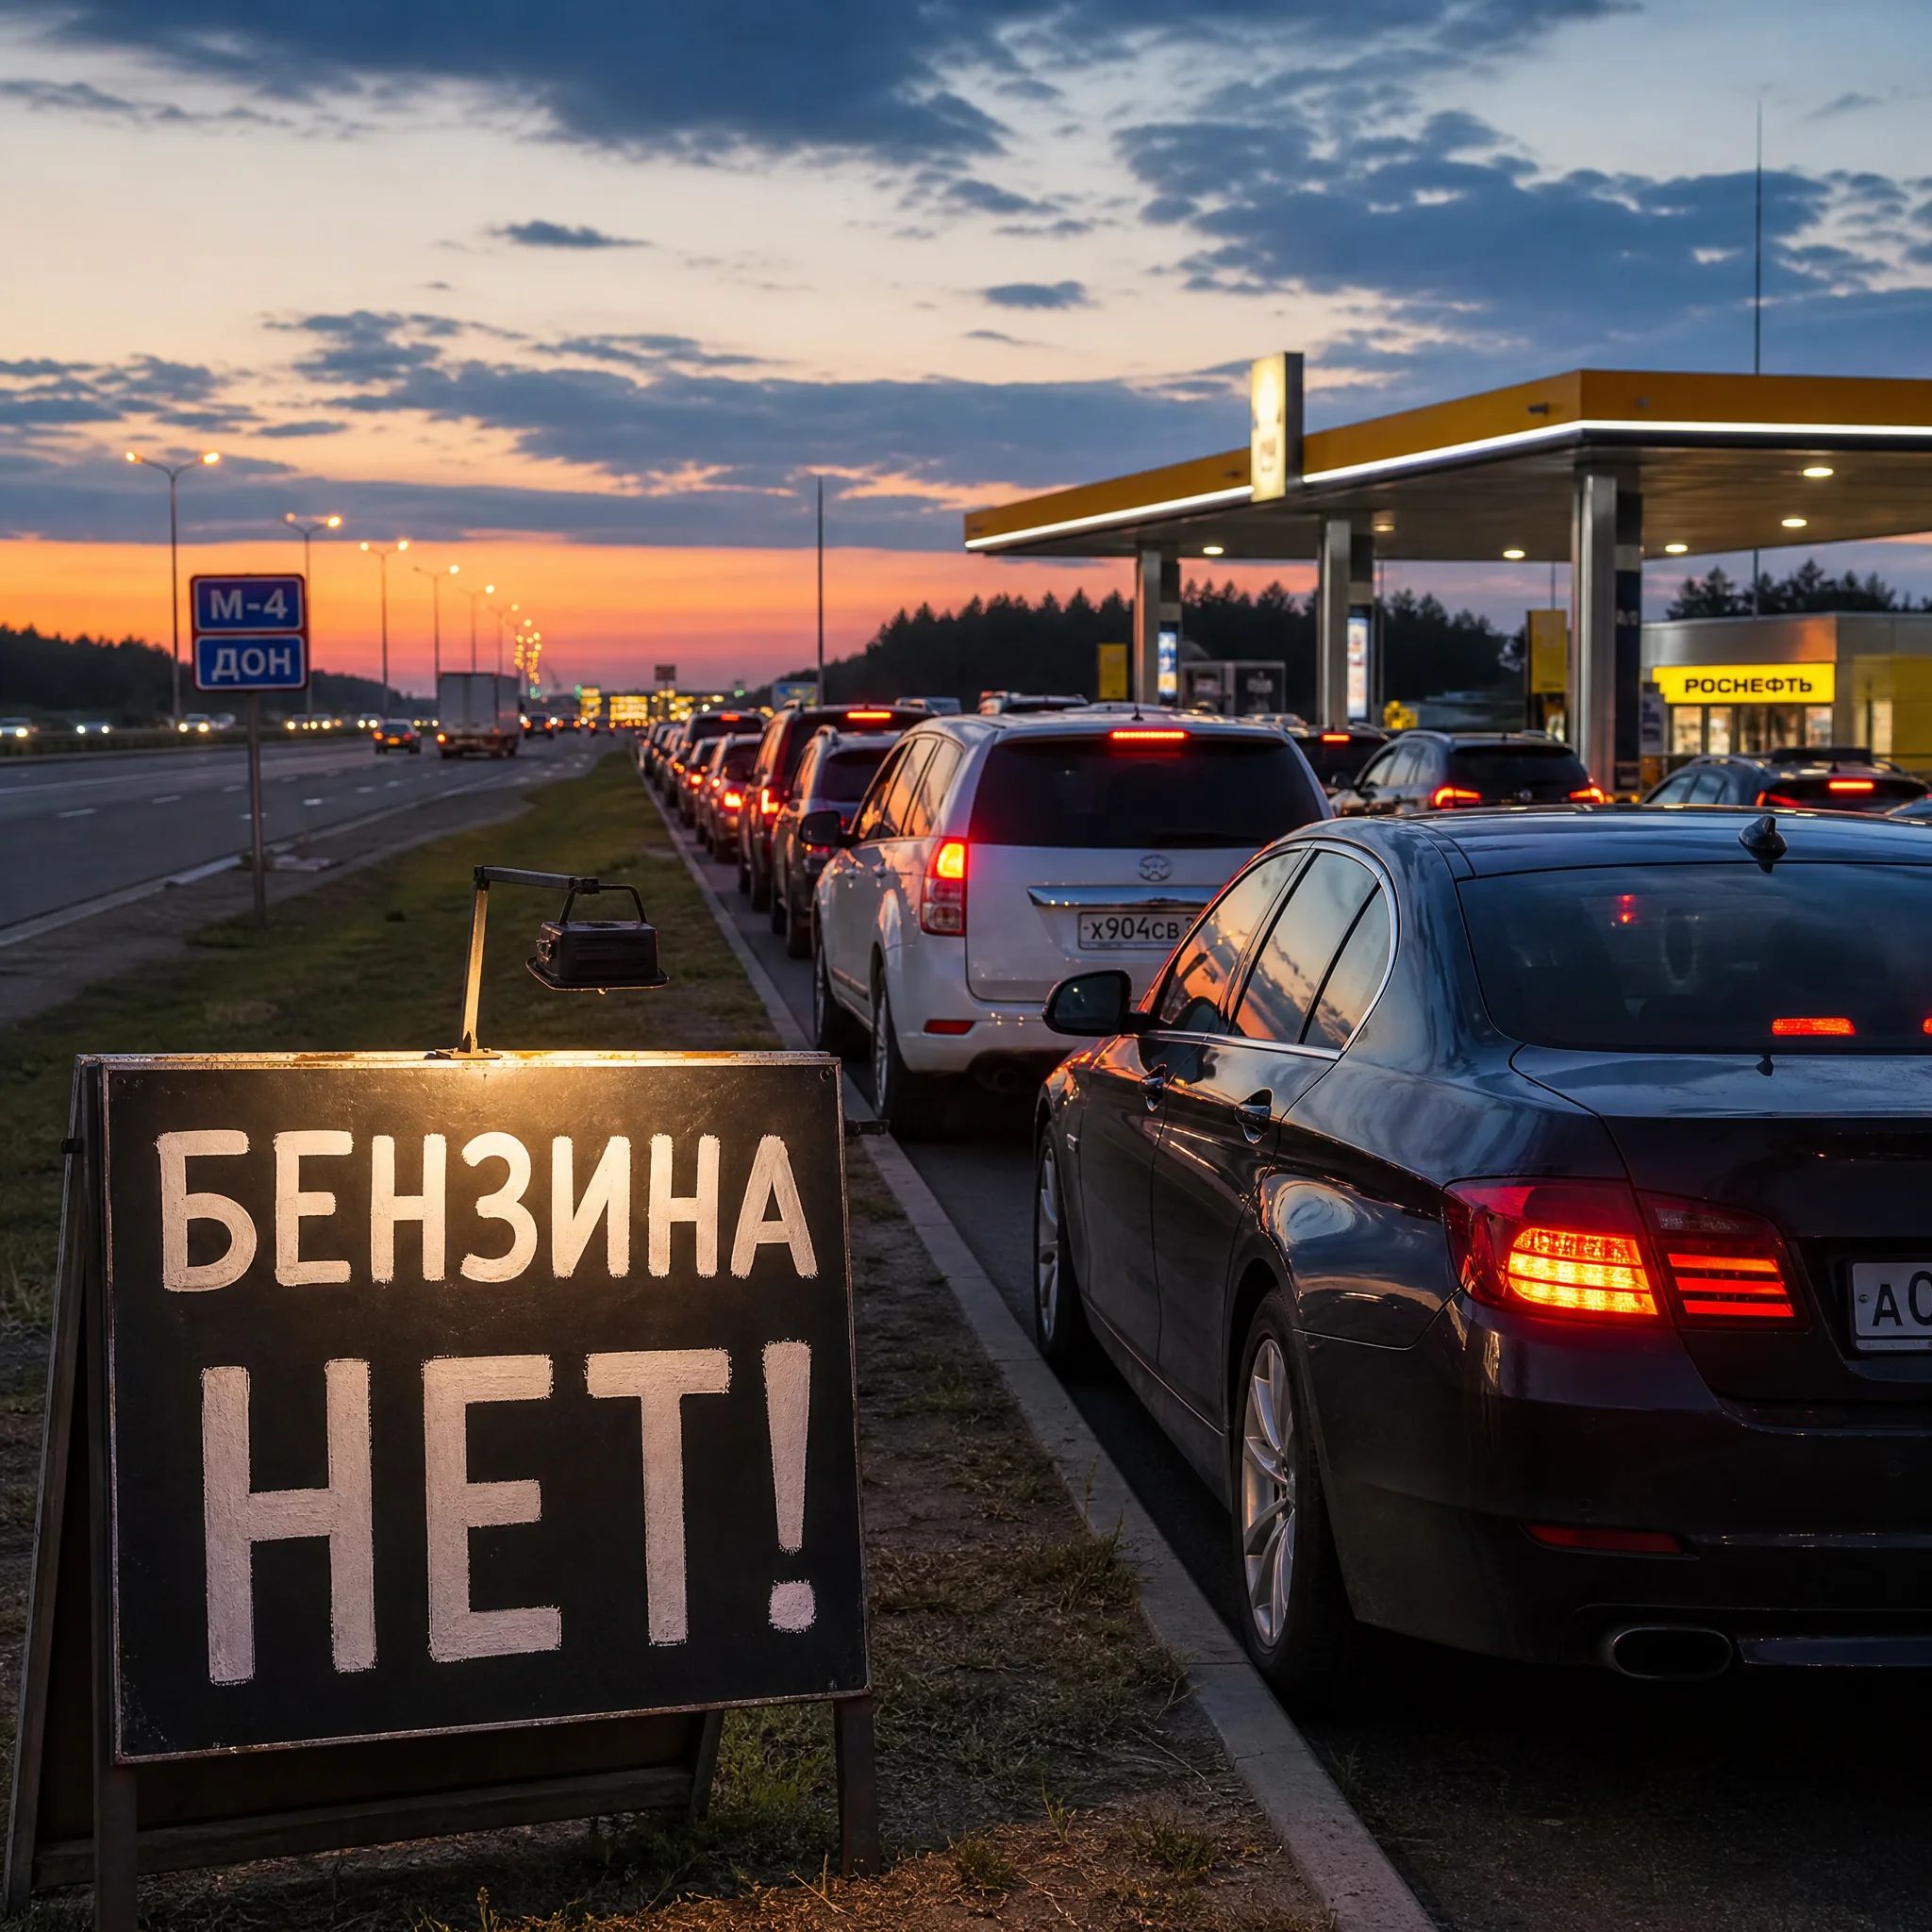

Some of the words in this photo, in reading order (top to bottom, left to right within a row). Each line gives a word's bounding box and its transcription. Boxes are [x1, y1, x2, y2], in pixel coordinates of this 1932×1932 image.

[209, 588, 288, 621] М-4
[211, 647, 291, 682] ДОН
[1685, 677, 1812, 693] РОСНЕФТЬ
[155, 1128, 819, 1292] БЕНЗИНА
[200, 1340, 817, 1684] НЕТ!
